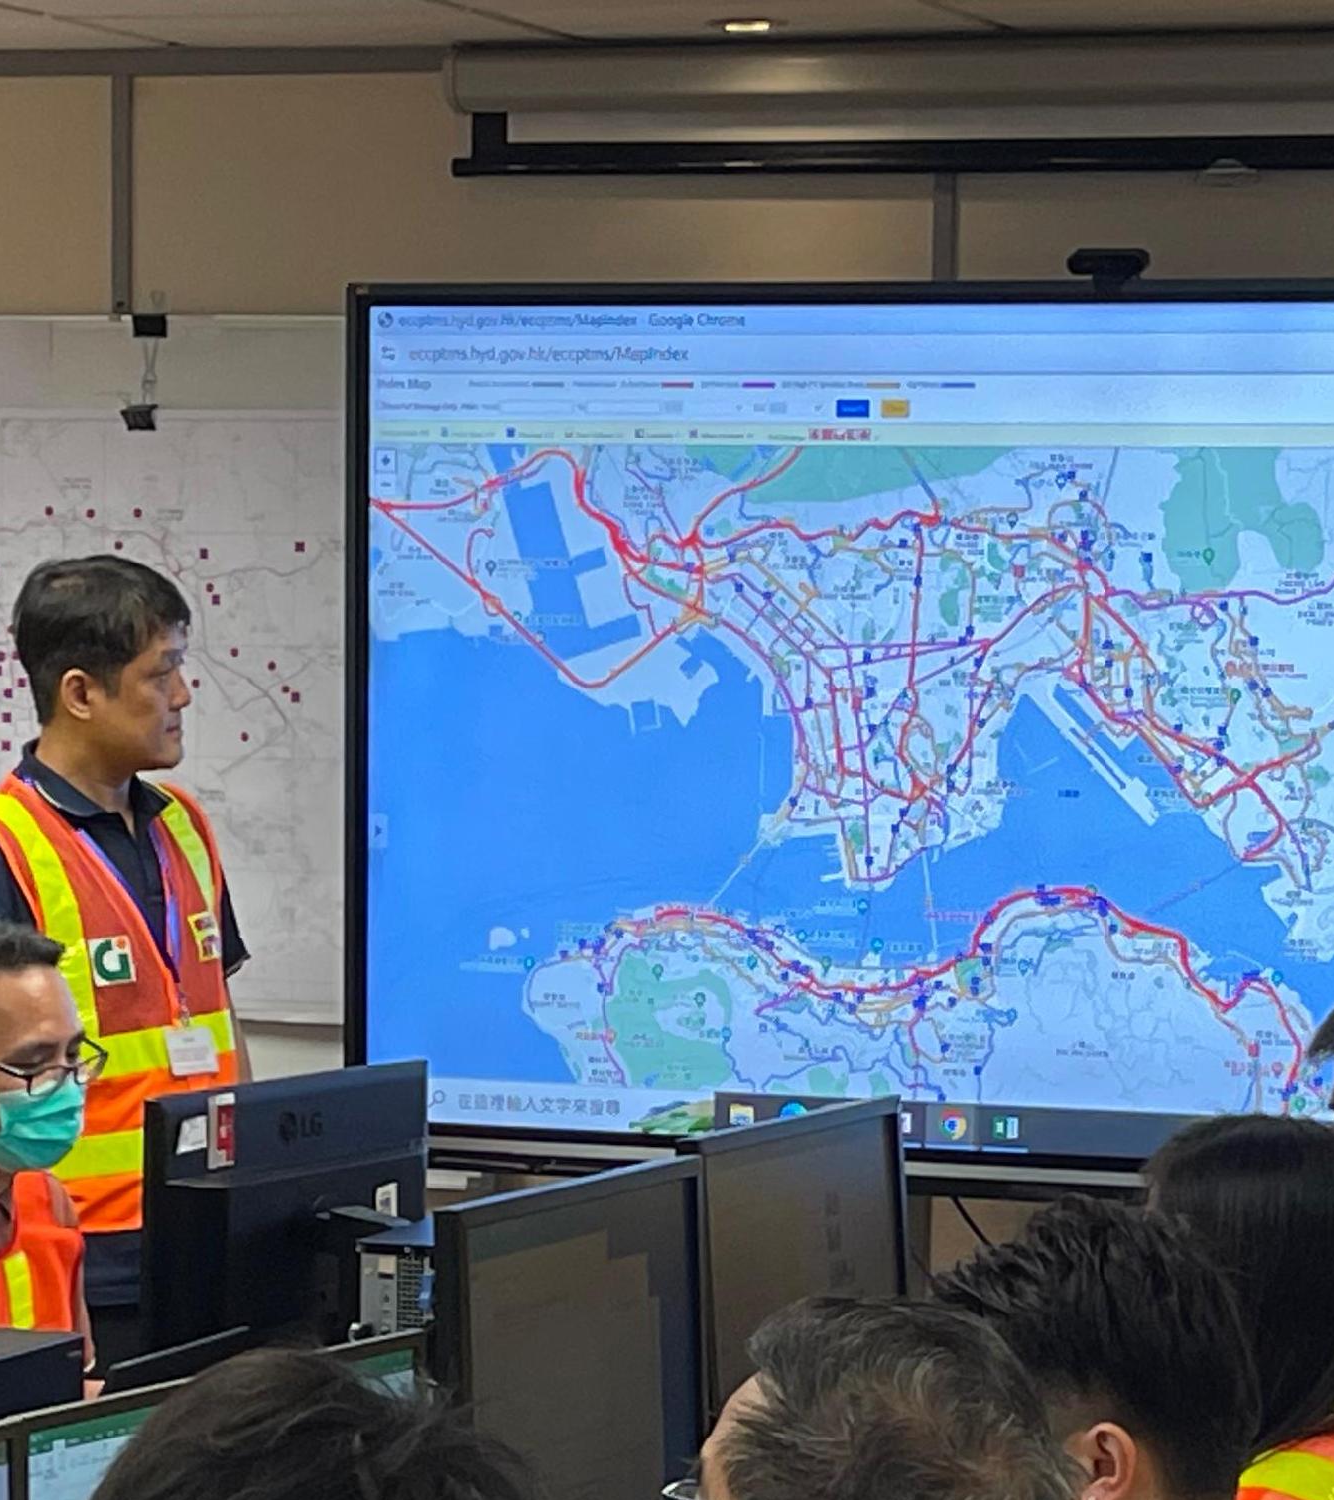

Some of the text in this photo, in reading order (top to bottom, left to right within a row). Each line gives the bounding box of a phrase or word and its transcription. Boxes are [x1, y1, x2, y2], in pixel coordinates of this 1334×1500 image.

[648, 312, 693, 330] Google
[697, 313, 745, 327] Chrome
[300, 1111, 324, 1138] LG
